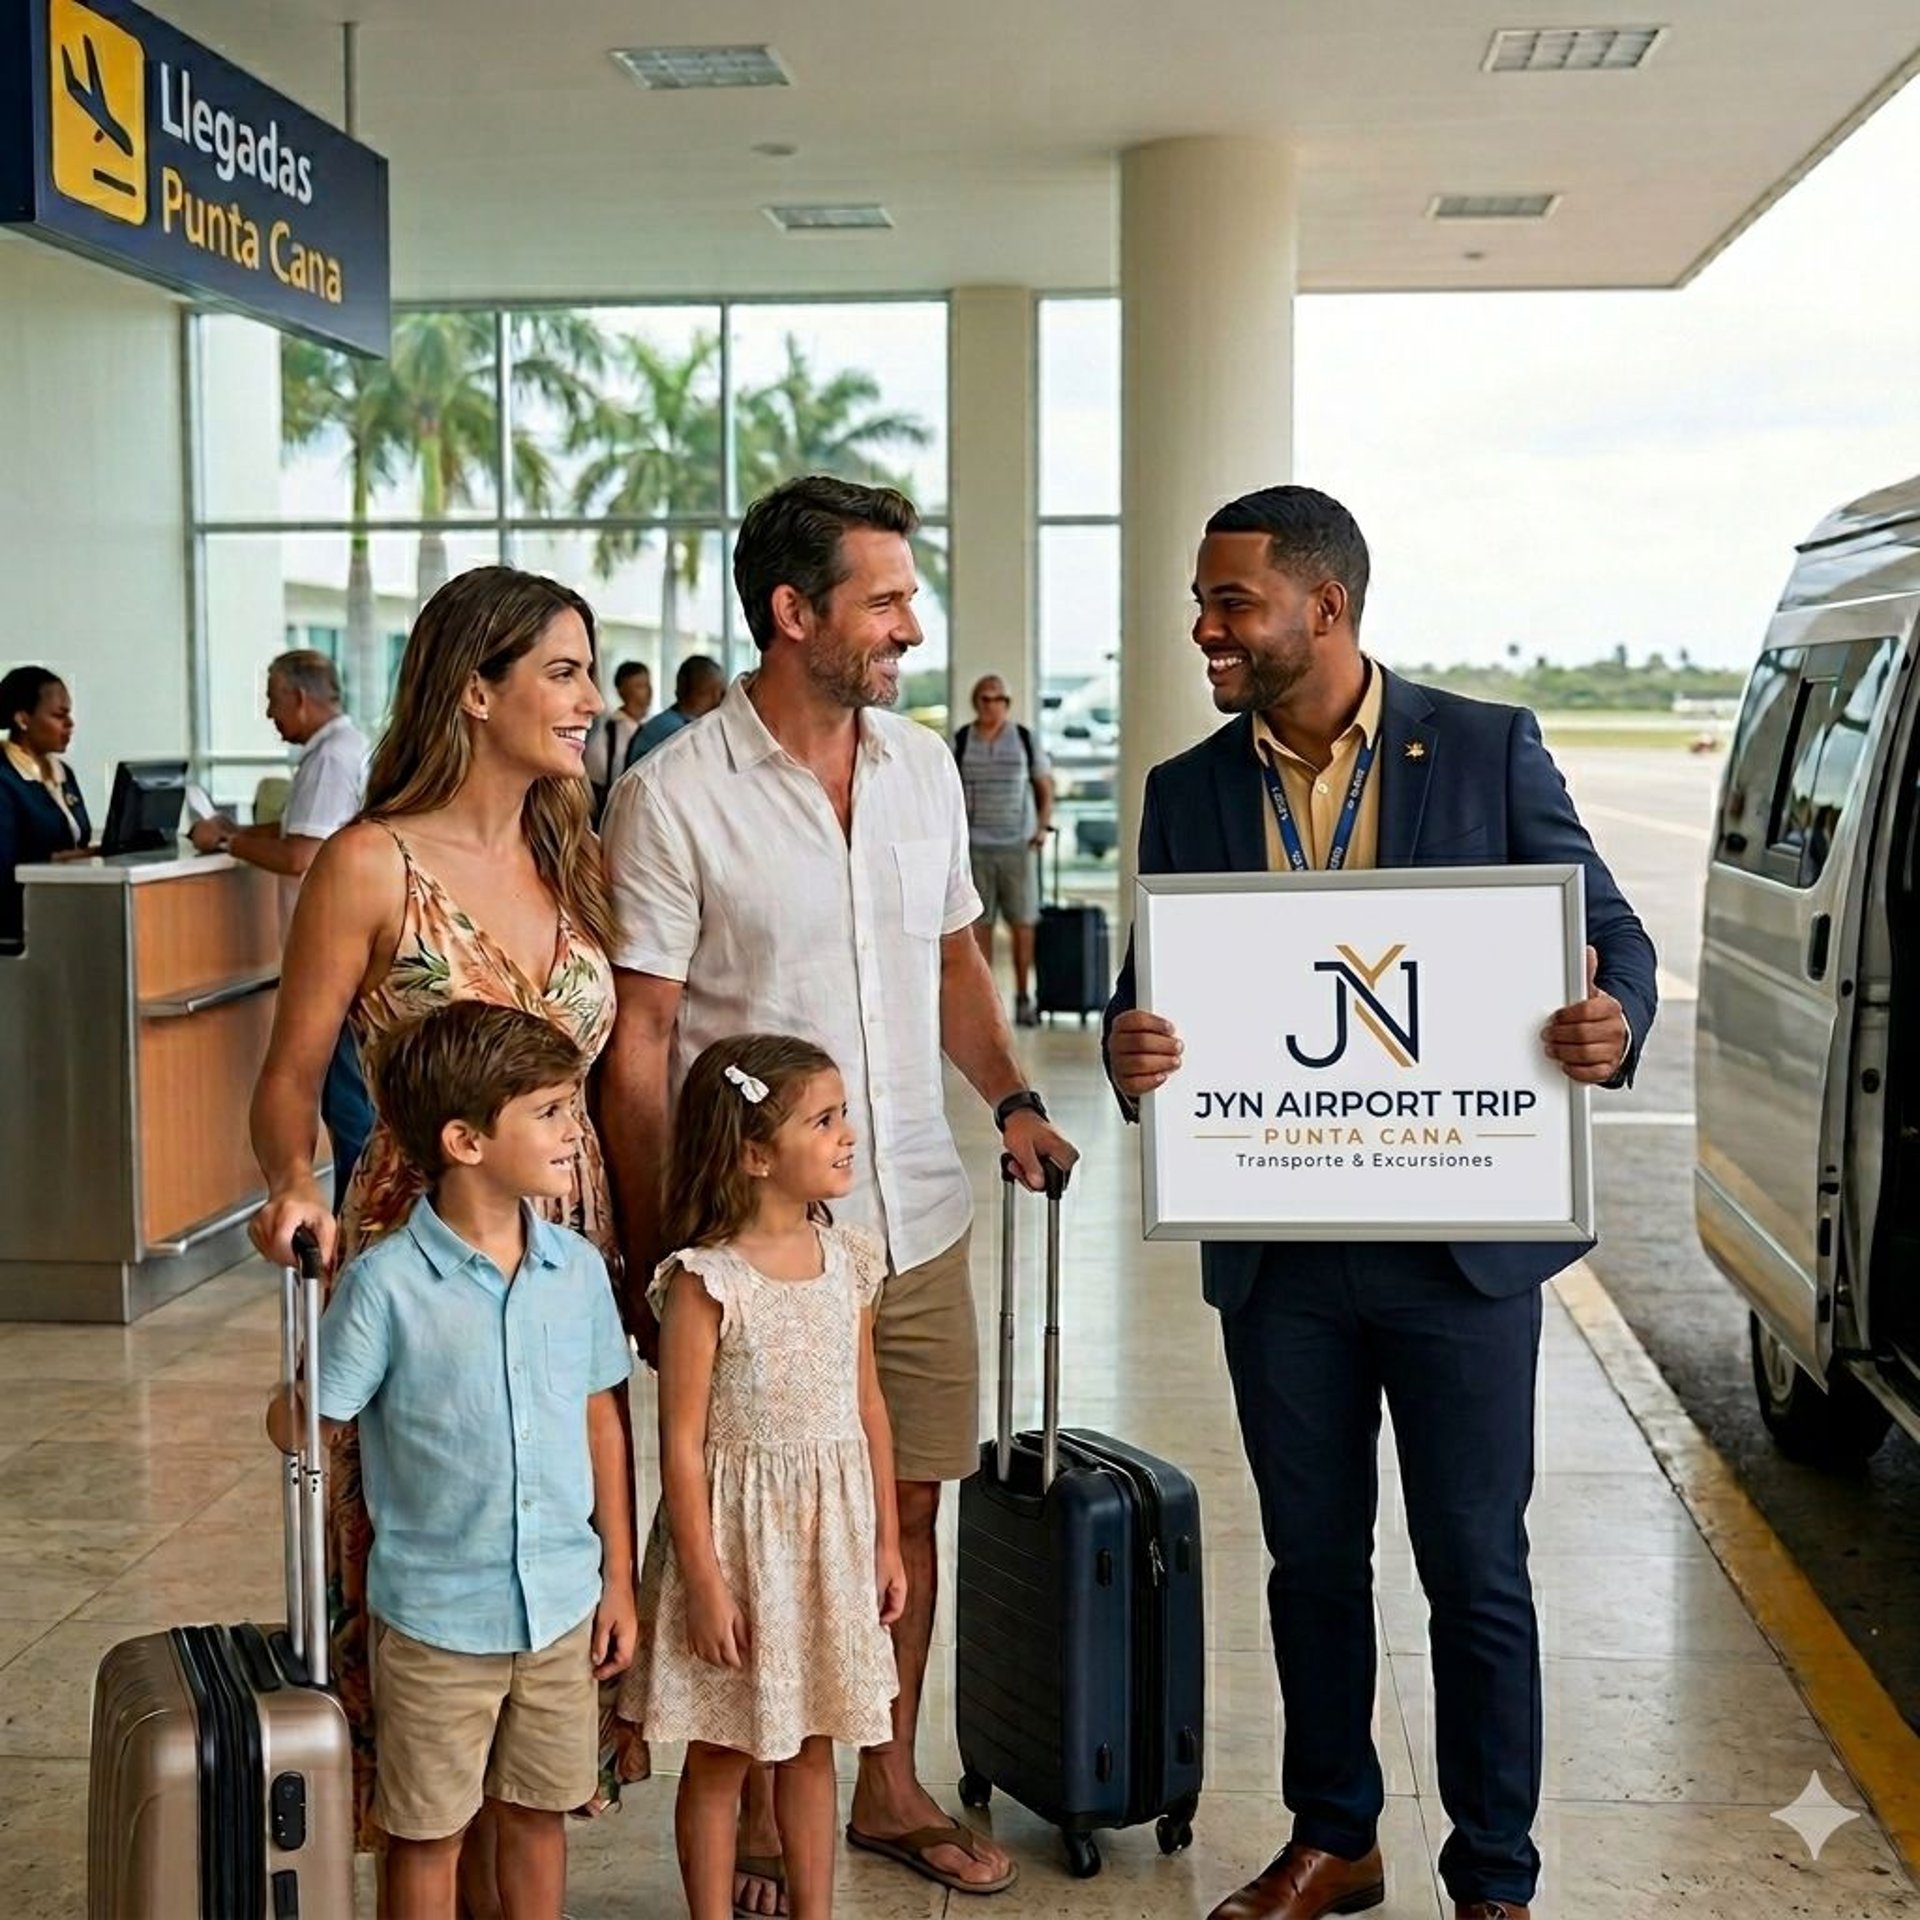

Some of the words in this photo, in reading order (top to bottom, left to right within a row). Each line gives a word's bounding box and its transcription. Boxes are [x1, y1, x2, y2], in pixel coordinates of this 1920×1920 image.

[160, 61, 312, 205] Llegadas
[162, 166, 260, 271] Punta
[269, 220, 343, 304] Cana
[1193, 1091, 1263, 1119] JYN
[1275, 1090, 1443, 1118] AIRPORT
[1452, 1089, 1537, 1117] TRIP
[1265, 1128, 1364, 1145] PUNTA
[1380, 1128, 1463, 1145] CANA
[1236, 1153, 1344, 1171] Transporte
[1352, 1152, 1364, 1168] &
[1372, 1152, 1494, 1168] Excursiones
